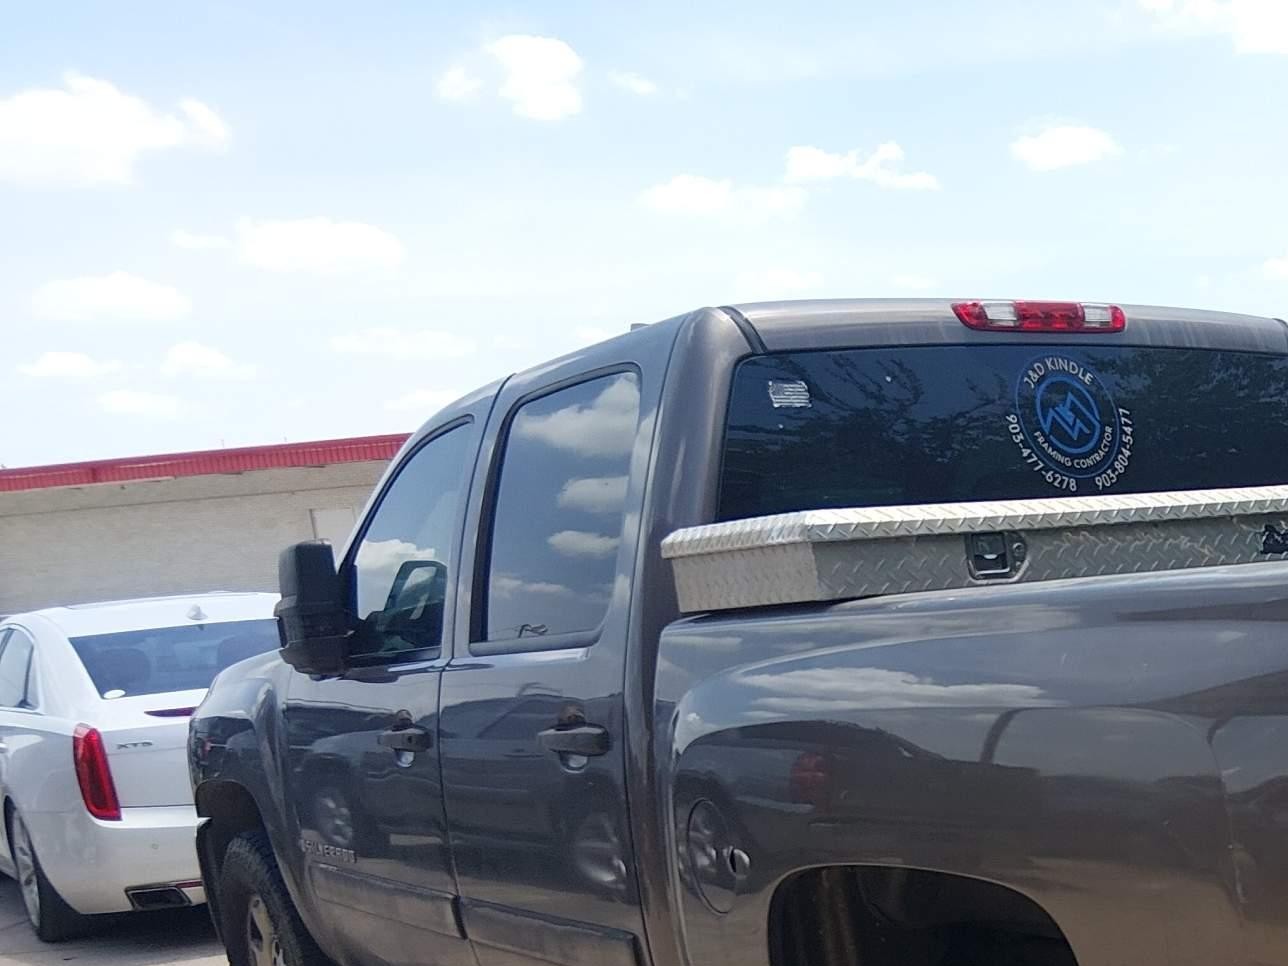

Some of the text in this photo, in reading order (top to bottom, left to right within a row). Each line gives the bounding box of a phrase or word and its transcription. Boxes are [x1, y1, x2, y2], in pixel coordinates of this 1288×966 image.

[1023, 357, 1094, 389] J&D KINDLE
[1005, 413, 1078, 492] 903-477-6278
[1033, 425, 1114, 469] FRAMING CONTRACTOR
[1094, 407, 1135, 491] 903-804-5477
